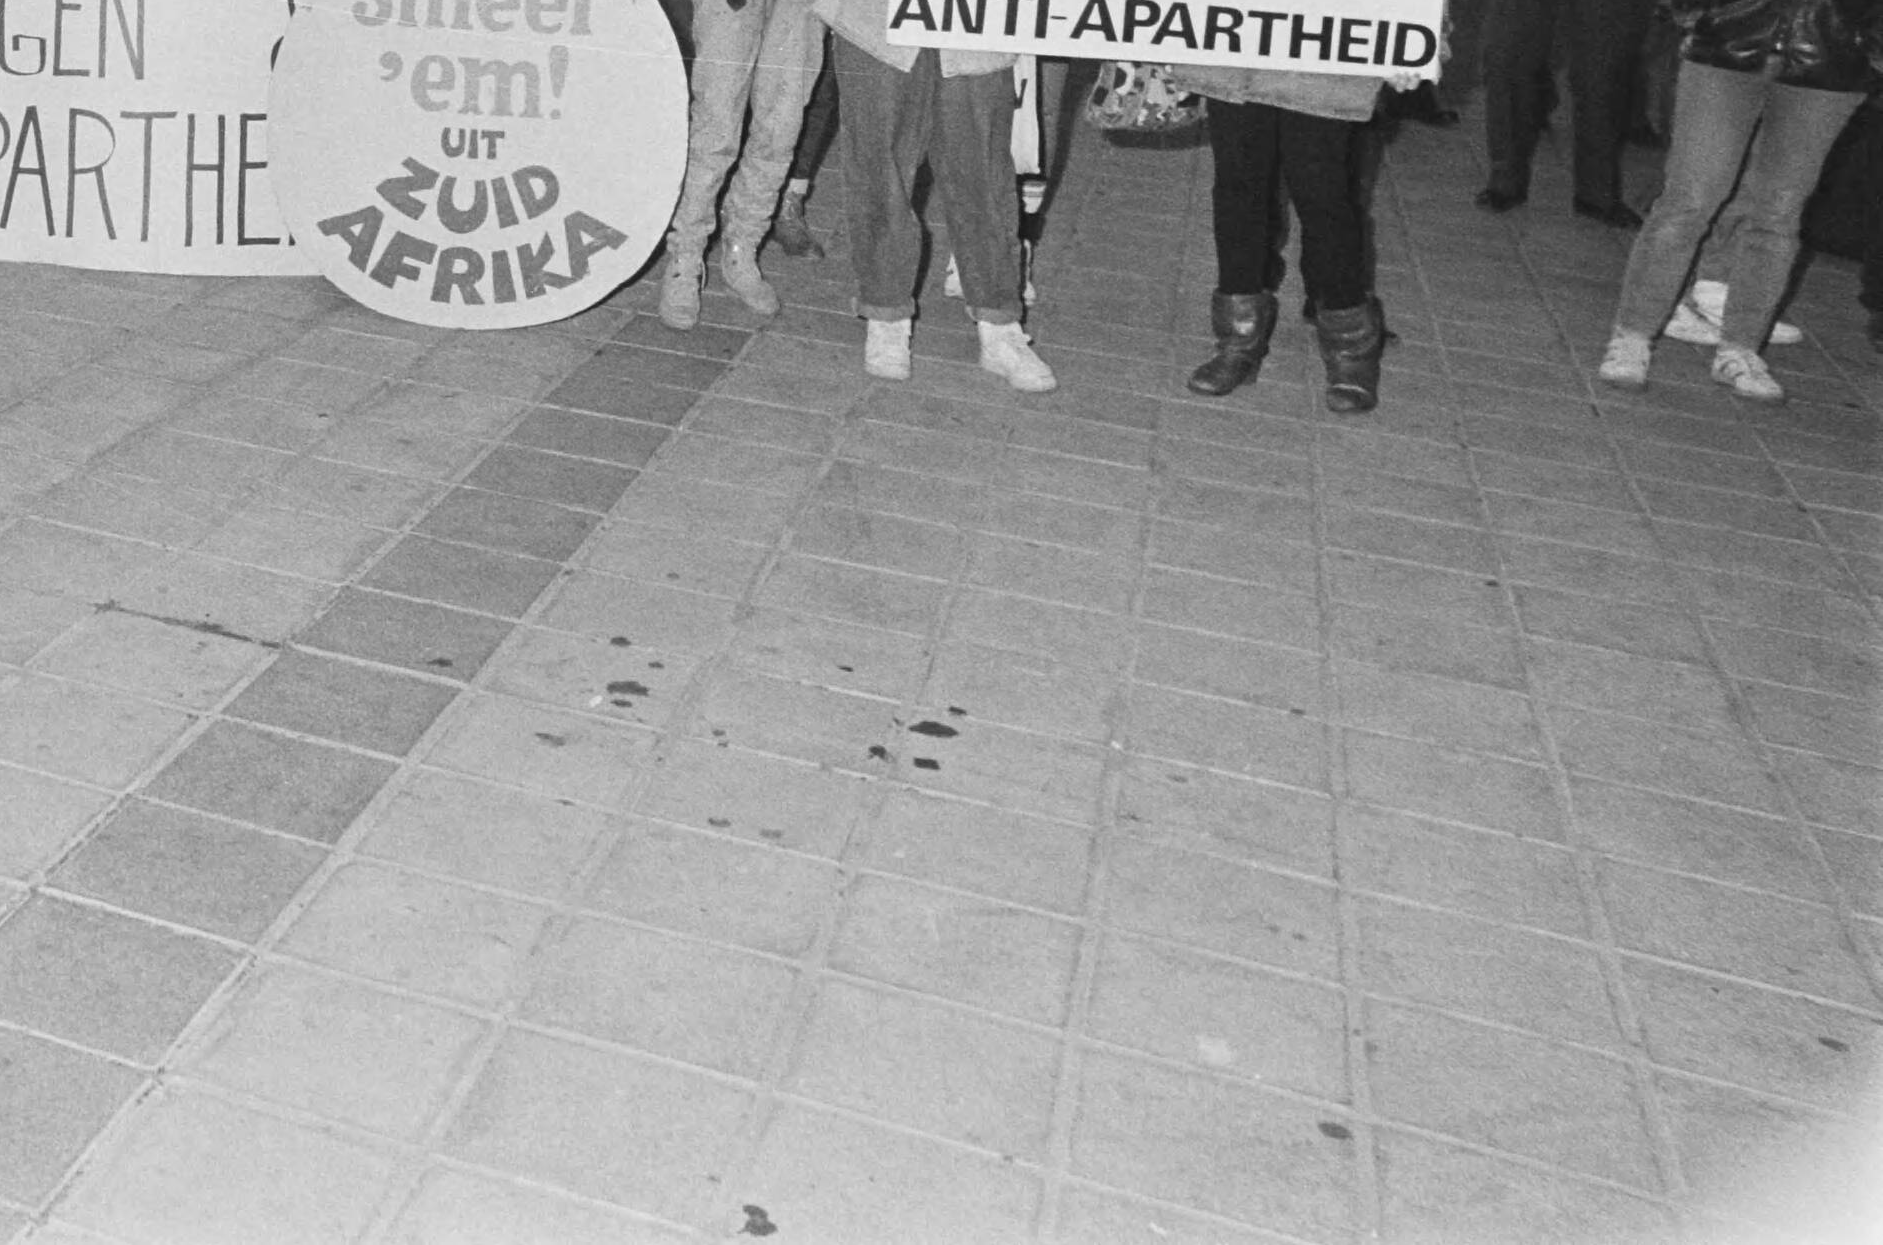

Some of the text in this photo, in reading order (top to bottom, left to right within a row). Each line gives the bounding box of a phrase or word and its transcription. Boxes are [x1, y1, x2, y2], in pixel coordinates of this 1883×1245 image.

[440, 127, 506, 160] UIT
[375, 157, 561, 234] ZUID
[317, 205, 630, 306] AFRIKA
